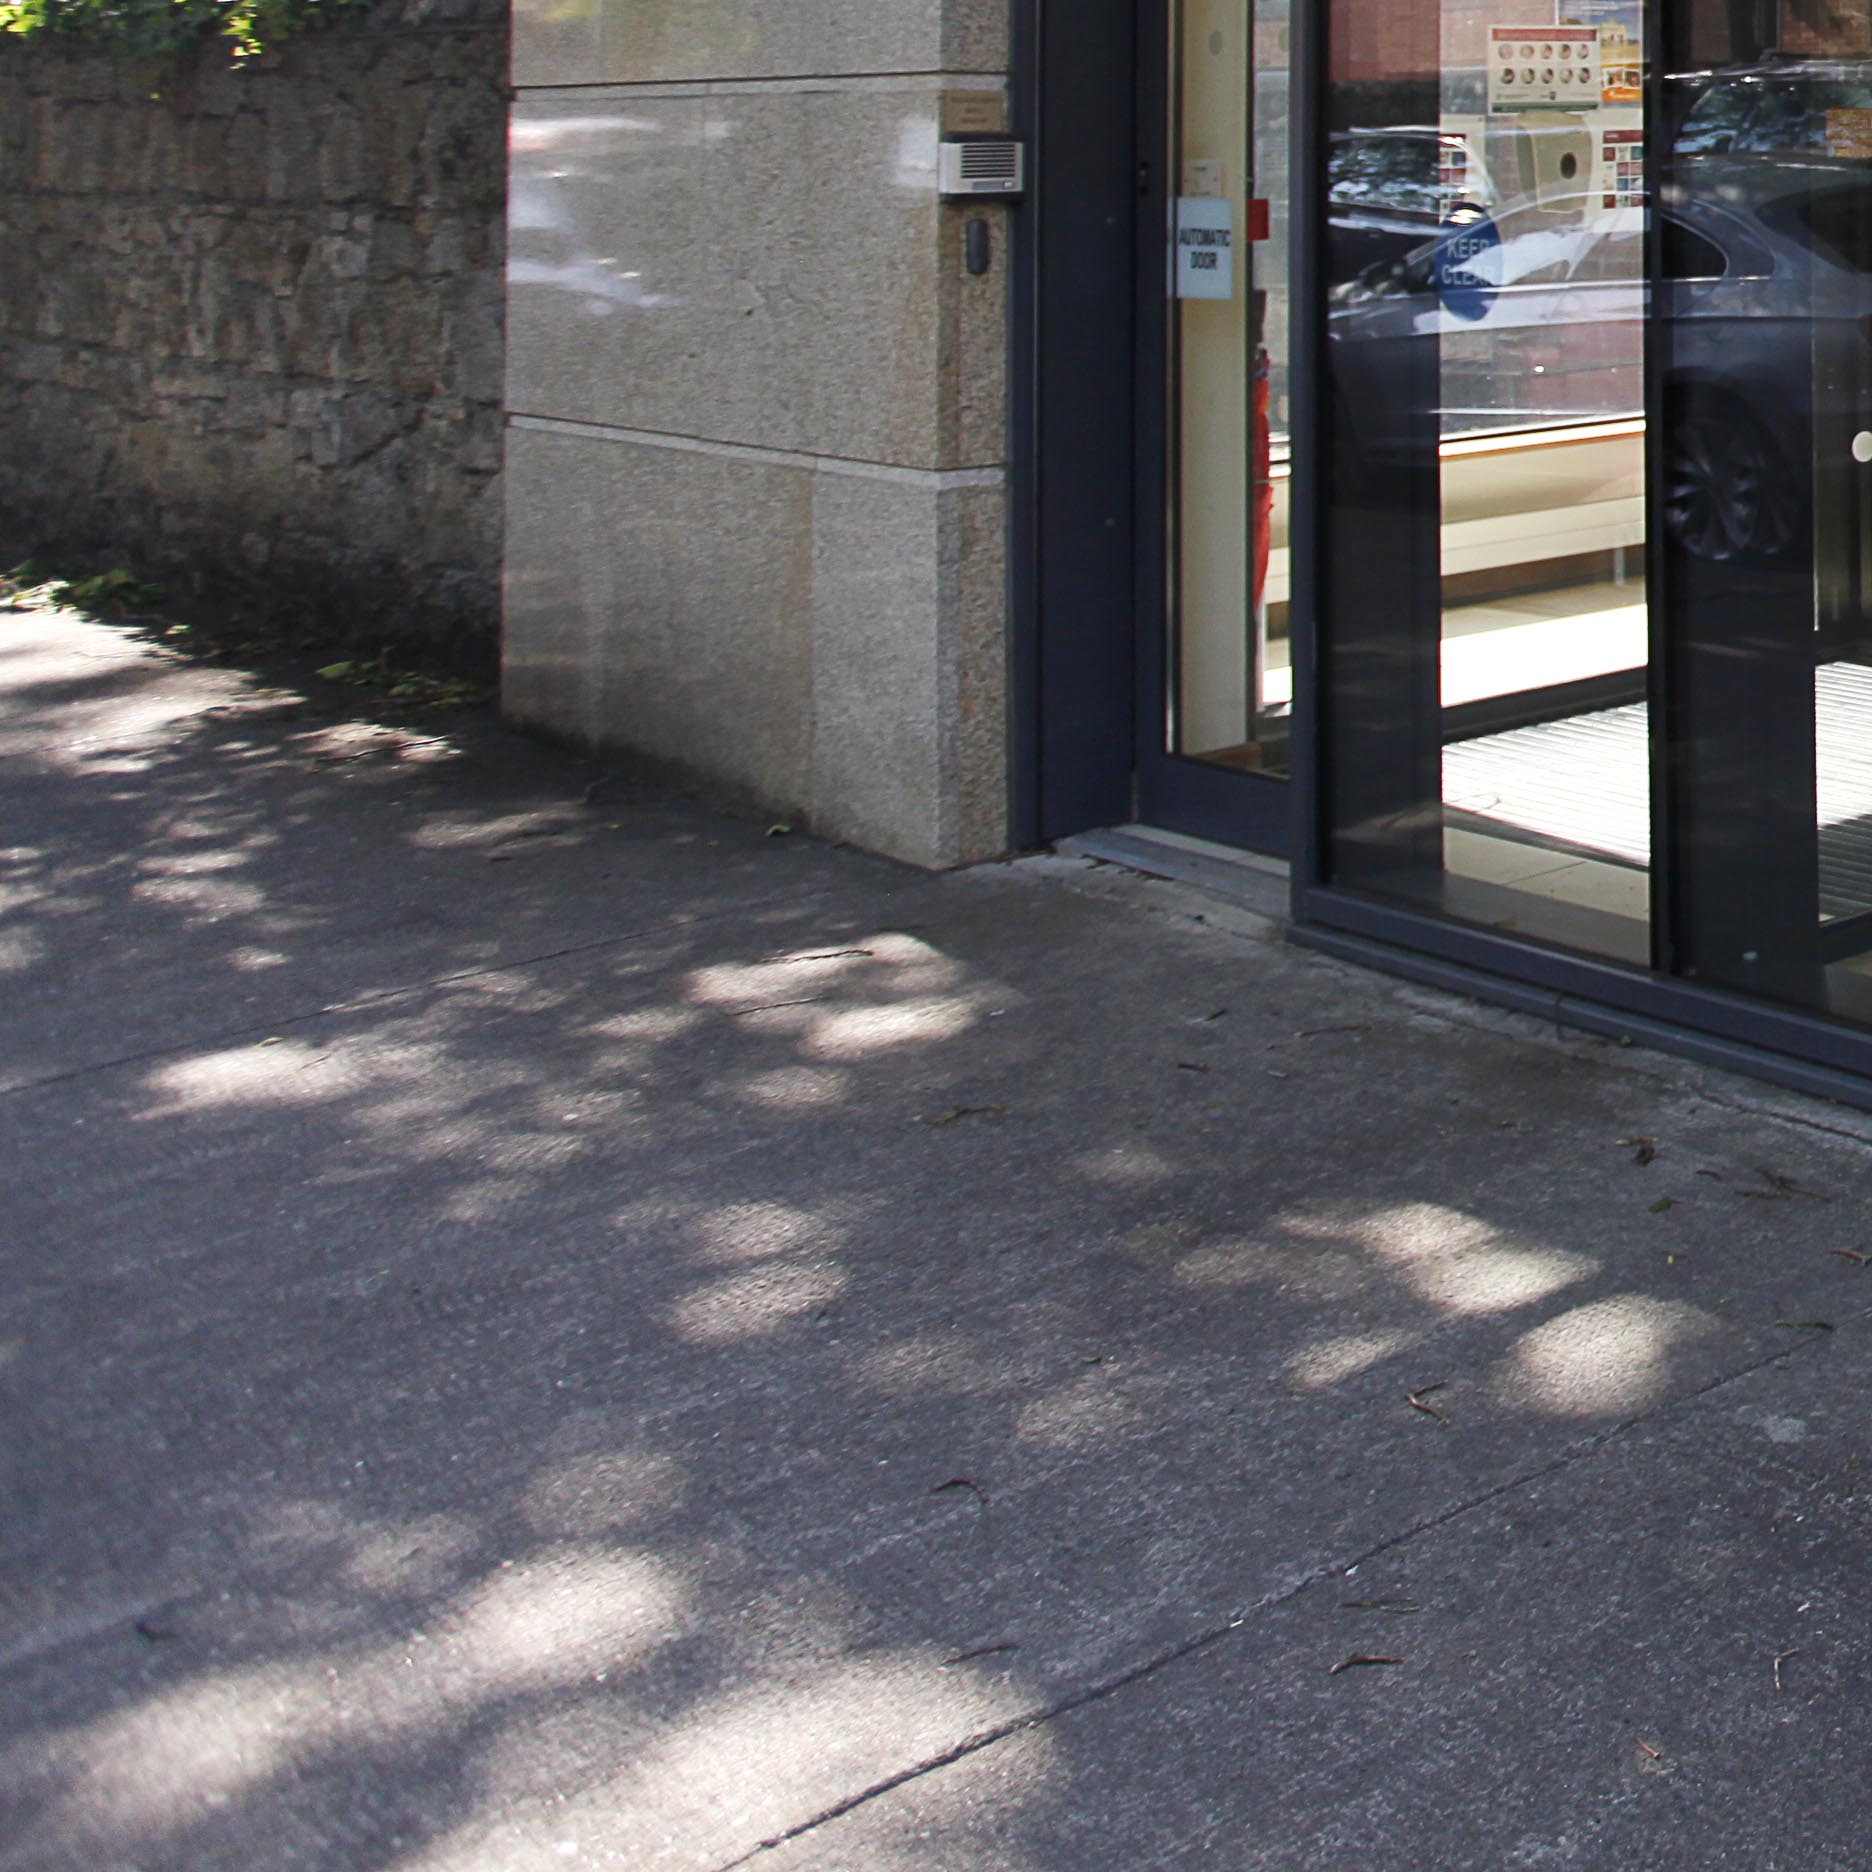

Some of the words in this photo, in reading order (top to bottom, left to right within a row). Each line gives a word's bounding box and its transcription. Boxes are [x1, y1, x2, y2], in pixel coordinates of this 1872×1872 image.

[1180, 228, 1231, 247] AUTOMATIC
[1447, 238, 1490, 259] KEEP
[1190, 251, 1217, 269] DOOR
